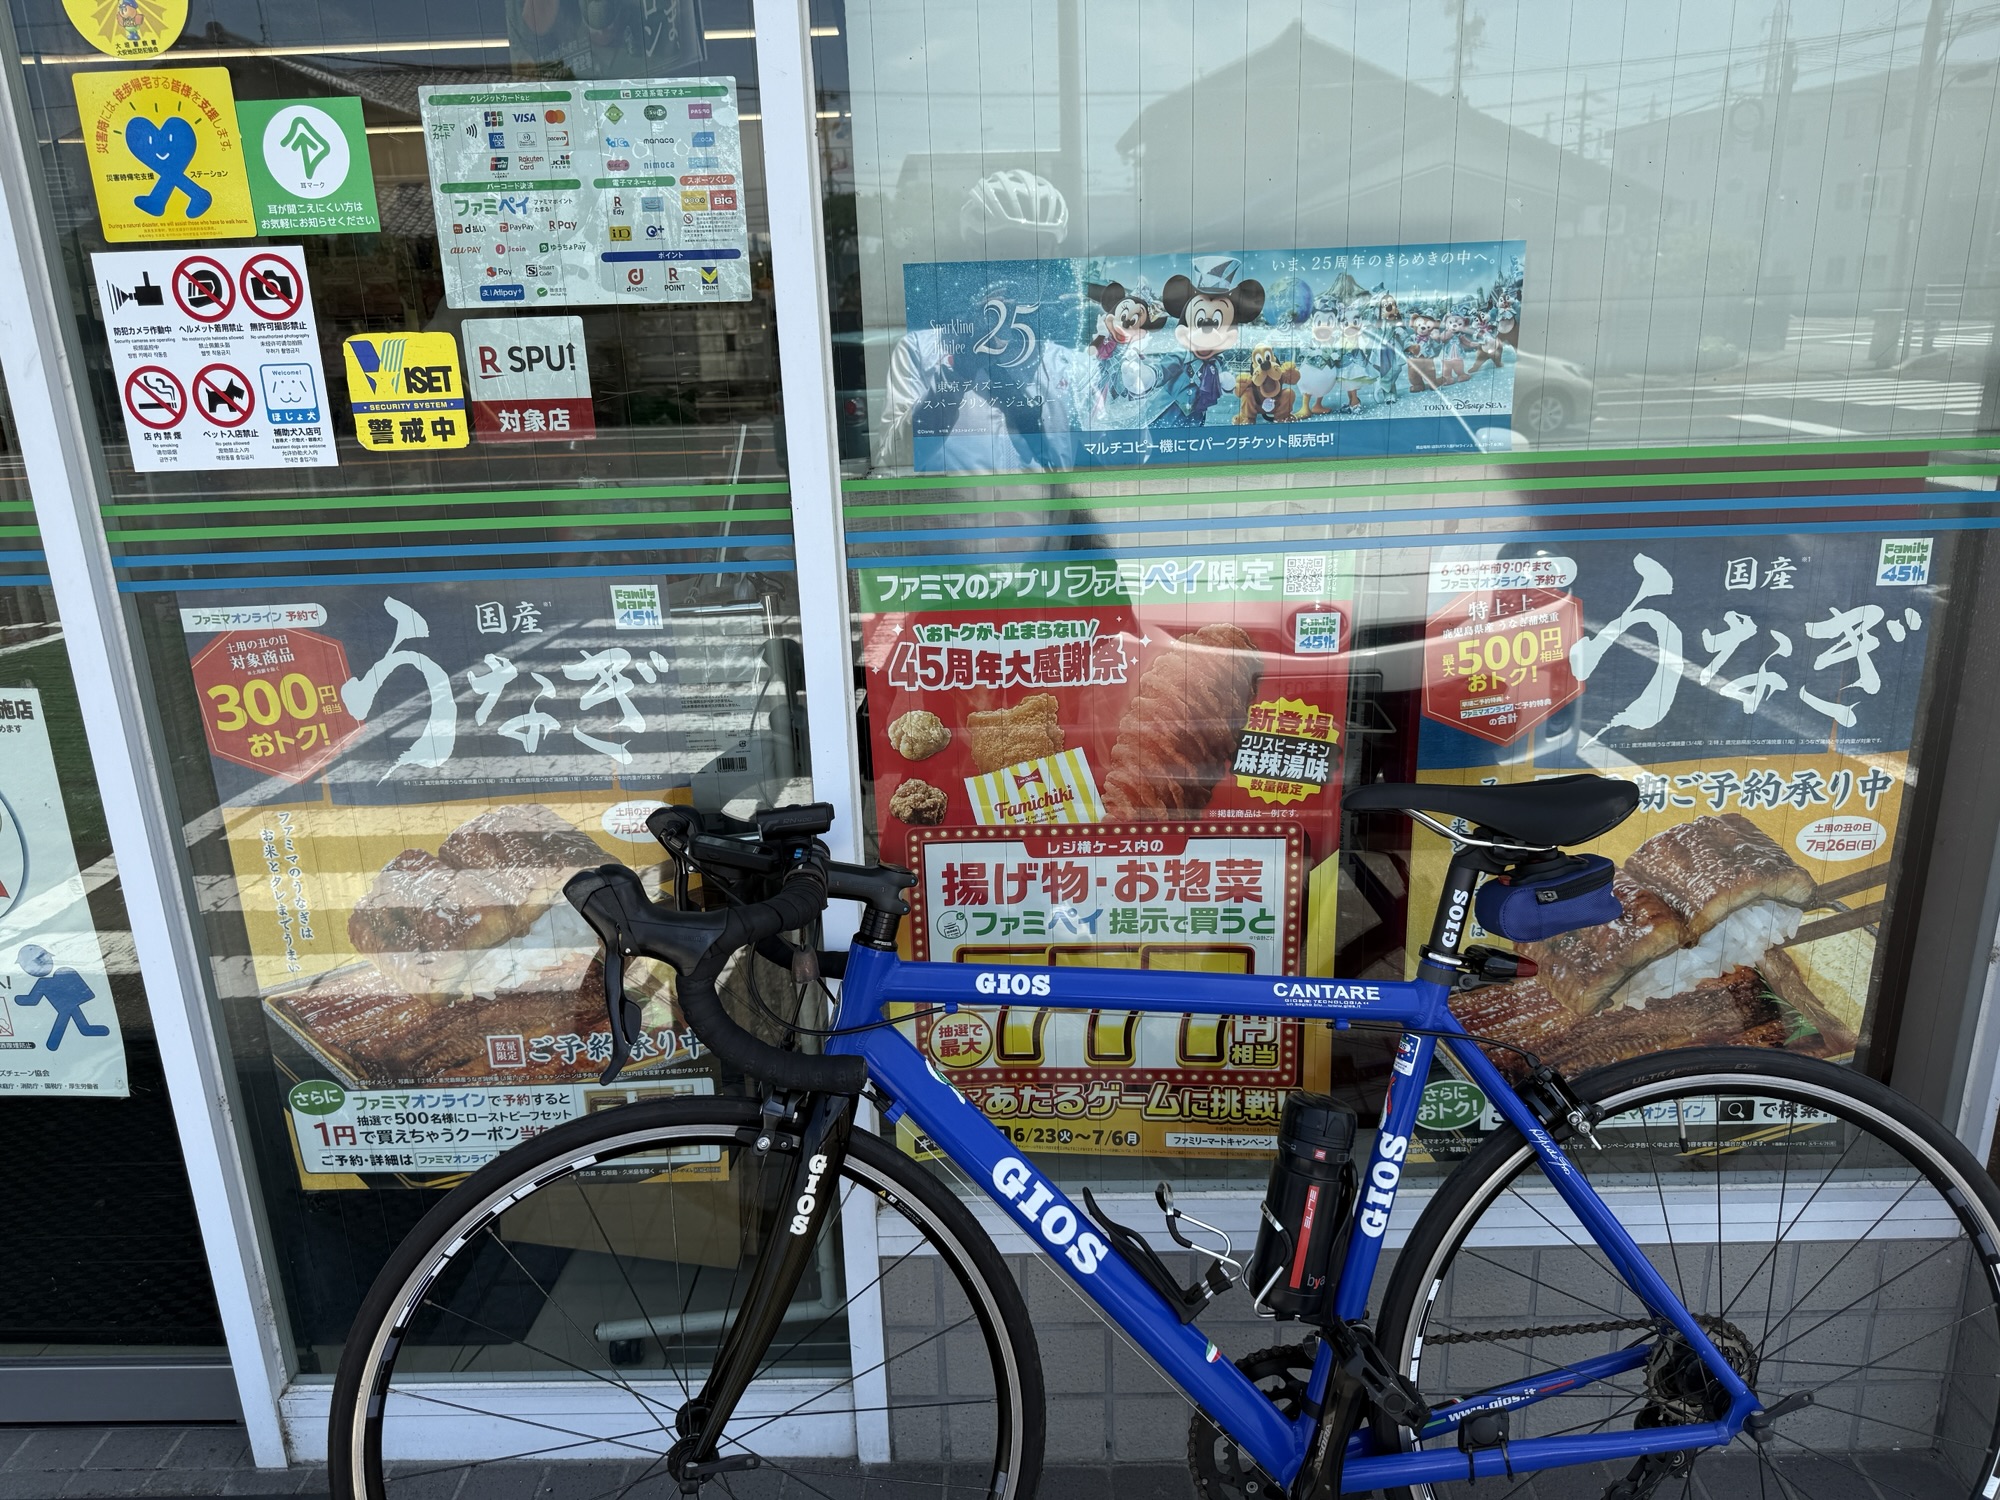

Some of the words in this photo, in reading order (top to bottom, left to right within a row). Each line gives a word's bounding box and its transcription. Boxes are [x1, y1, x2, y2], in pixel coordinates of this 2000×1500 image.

[512, 112, 537, 123] VISA
[431, 123, 455, 132] ファミマ
[643, 137, 675, 145] manaca
[518, 155, 544, 165] Rakuten
[519, 163, 535, 171] Card
[643, 160, 675, 169] nimoca
[106, 172, 155, 182] 災害時帰宅支援
[190, 170, 228, 178] ステーション
[687, 175, 728, 184] スポーツくじ
[267, 202, 364, 215] 耳が聞こえにくい方は
[454, 196, 530, 217] ファミペイ
[261, 215, 376, 229] お気軽にお知らせください
[509, 223, 535, 231] PayPay
[467, 246, 481, 254] PAY
[658, 252, 684, 260] ポイント
[1272, 250, 1496, 272] いま、25周年のきらめきの中へ。
[498, 267, 512, 276] Pay
[664, 284, 686, 292] POINT
[113, 325, 172, 336] 防犯カメラ作動中
[179, 323, 245, 333] ヘルメット着用禁止
[250, 321, 307, 332] 無許可撮影禁止
[930, 319, 974, 337] Sparkling
[936, 380, 1036, 393] 東京ディズニーシー
[369, 402, 411, 411] SECURITY
[413, 401, 448, 410] SYSTEM
[271, 410, 317, 422] ほじょ犬
[499, 408, 571, 432] 対象店
[143, 431, 182, 441] 店内禁煙
[203, 429, 259, 439] ペット入店禁止
[273, 427, 322, 437] 補助犬入店可
[368, 416, 456, 444] 警戒中
[1084, 432, 1335, 456] マルチコピー機にてパークチケット販売中!
[1885, 542, 1929, 554] Family
[1883, 553, 1928, 565] Mart
[1534, 574, 1567, 586] 予約で
[1724, 556, 1798, 592] 国産
[1881, 564, 1925, 582] 45th
[615, 588, 658, 600] Family
[617, 599, 658, 610] Mart
[192, 611, 283, 626] ファミマオンライン
[286, 610, 319, 621] 予約で
[475, 600, 544, 635] 国産
[619, 609, 661, 627] 45th
[226, 634, 289, 654] 土用の丑の日
[1299, 635, 1336, 649] 45th
[1540, 627, 1562, 649] 円
[229, 647, 295, 671] 対象商品
[1457, 630, 1539, 675] 500
[1540, 649, 1564, 663] 相当
[1569, 553, 1922, 750] うなぎ
[891, 636, 1126, 688] 45周年大感謝祭
[1468, 666, 1538, 692] おトク!
[318, 685, 338, 704] 円
[340, 596, 669, 787] うなぎ
[207, 672, 319, 732] 300
[322, 703, 342, 715] 相当
[1248, 706, 1332, 739] 新登場
[1489, 713, 1518, 726] の合計
[248, 723, 331, 758] おトク!
[1241, 734, 1330, 758] クリスピーチキン
[1233, 748, 1329, 782] 麻辣湯味
[1250, 778, 1303, 796] 数量限定
[994, 784, 1075, 819] Famichiki
[1813, 821, 1872, 834] 土用の丑の日
[1047, 840, 1164, 855] レジ横ケース内の
[1806, 836, 1877, 854] 7月26日(日)
[279, 811, 314, 942] ファミマのうなぎは
[941, 857, 1264, 907] 揚げ物・お惣菜
[260, 828, 302, 975] お米とタレまでうまい
[1441, 889, 1469, 948] GIOS
[975, 972, 1051, 996] GIOS
[1273, 982, 1381, 1001] CANTARE
[938, 1022, 983, 1040] 抽選で
[496, 1040, 518, 1052] 数量
[939, 1039, 983, 1057] 最大
[496, 1051, 519, 1062] 限定
[1231, 1045, 1279, 1067] 相当
[1632, 1068, 1676, 1086] ULTRA
[293, 1086, 341, 1106] さらに
[1424, 1086, 1469, 1102] さらに
[357, 1109, 572, 1126] 抽選で500名様にローストビーフセット
[1418, 1099, 1478, 1121] おトク!
[1174, 1134, 1272, 1147] ファミリーマートキャンペーン
[321, 1153, 414, 1167] ご予約・詳細は
[1360, 1132, 1408, 1238] GIOS
[789, 1154, 828, 1236] GIOS
[992, 1156, 1109, 1275] GIOS
[1304, 1189, 1317, 1229] ELITE
[1318, 1424, 1333, 1458] SORA
